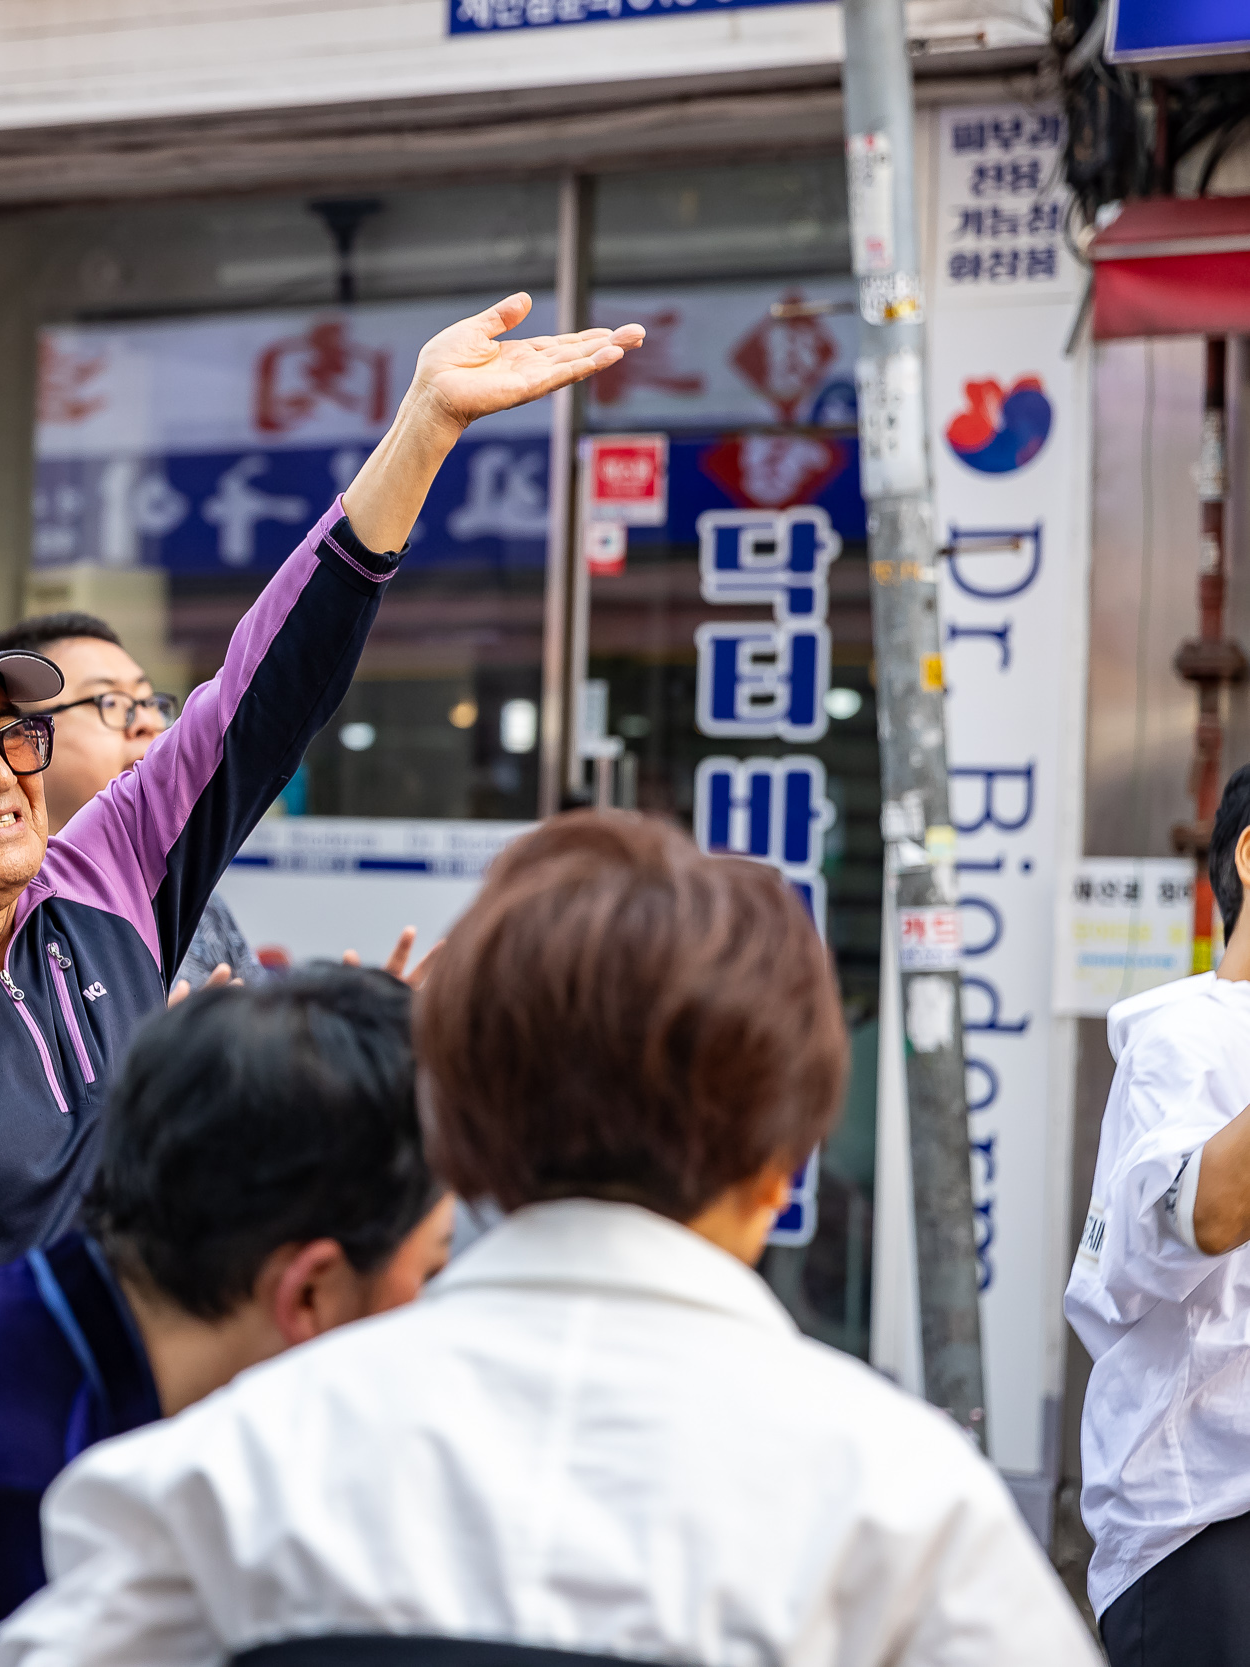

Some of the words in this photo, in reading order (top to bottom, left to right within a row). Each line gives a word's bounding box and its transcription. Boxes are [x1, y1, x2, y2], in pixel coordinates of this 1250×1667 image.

[952, 115, 1060, 152] 피부과
[955, 203, 1059, 236] 기능성
[949, 247, 1055, 281] 화장품
